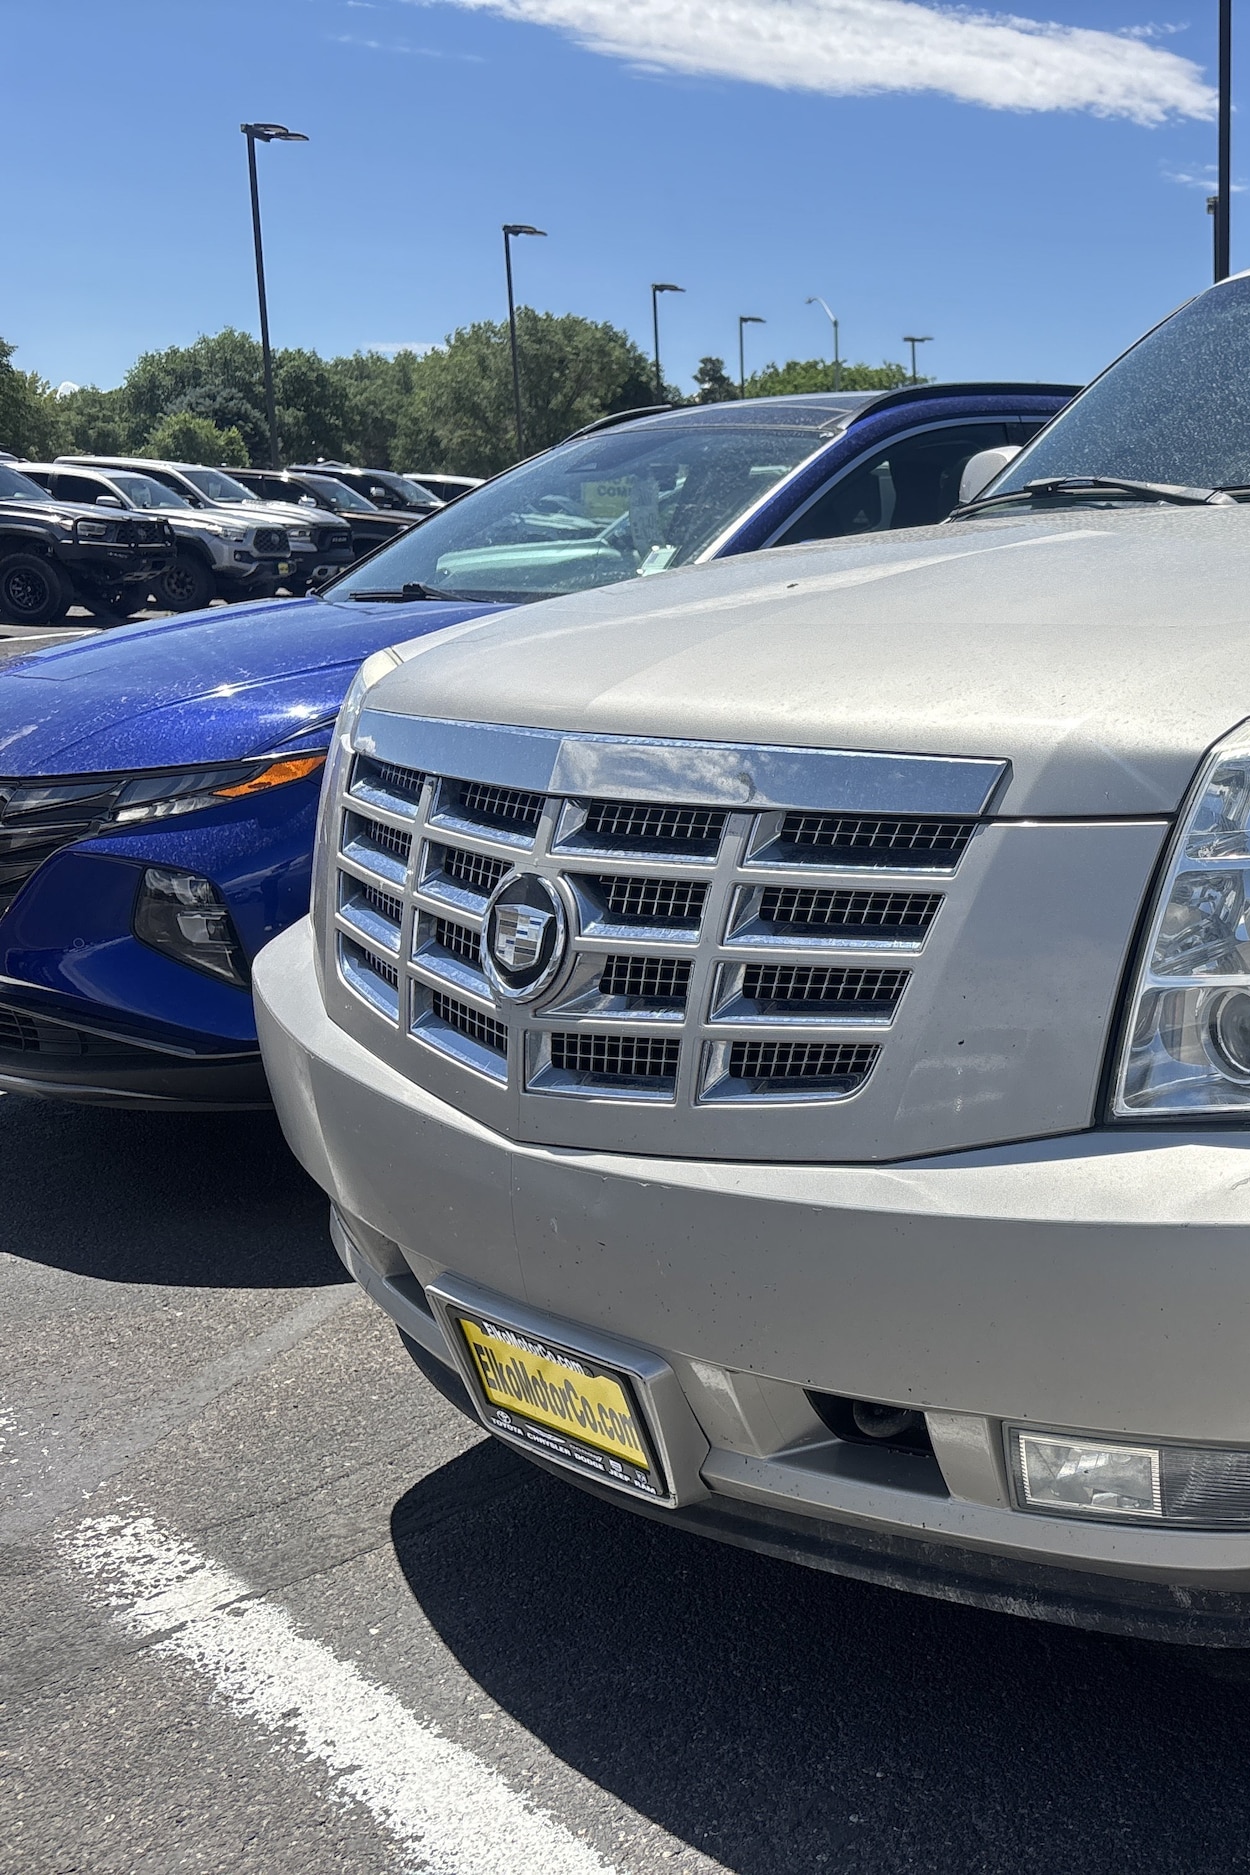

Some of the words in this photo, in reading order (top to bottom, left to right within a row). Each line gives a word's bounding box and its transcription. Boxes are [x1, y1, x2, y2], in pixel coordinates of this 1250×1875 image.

[482, 1321, 585, 1374] ElkoMotorCo.com
[473, 1342, 643, 1452] ElkoMotorCo.com
[491, 1417, 523, 1436] TOYOTA
[527, 1432, 571, 1457] CHRYSLER
[574, 1453, 605, 1472] DODGE
[608, 1468, 631, 1482] JEEP
[634, 1479, 657, 1495] RAM
